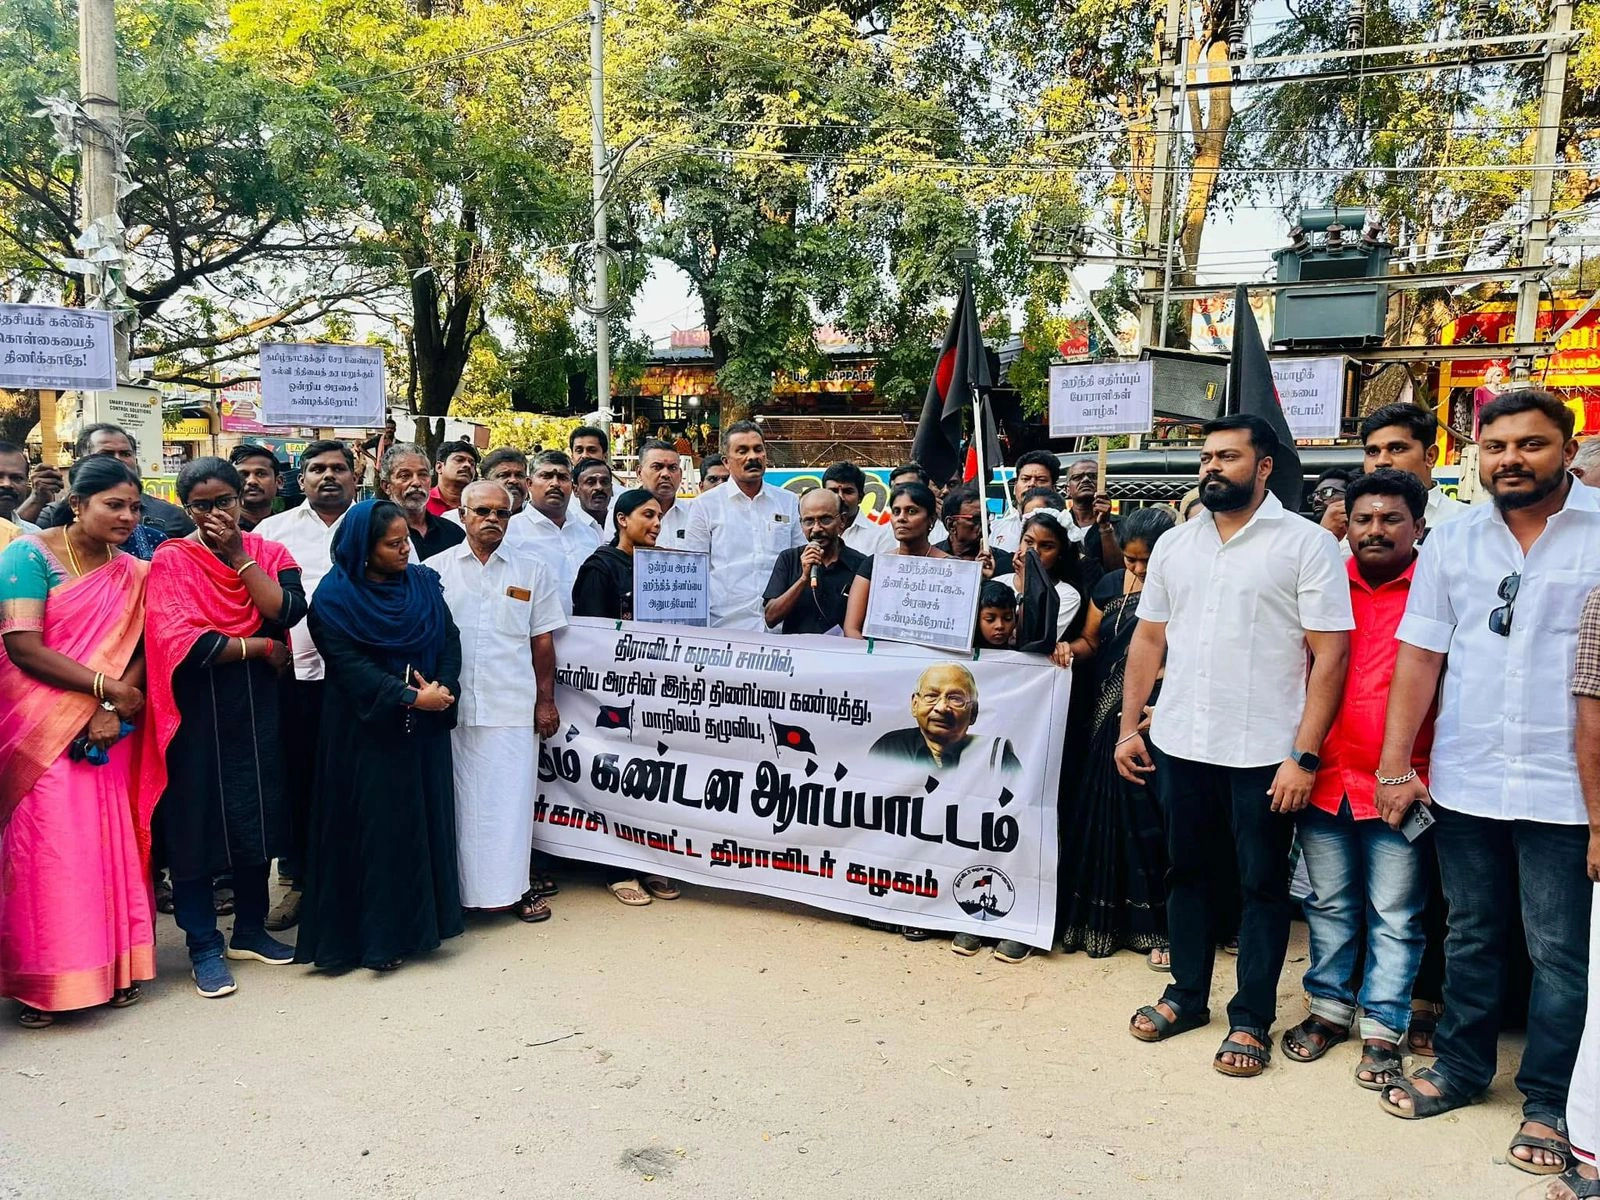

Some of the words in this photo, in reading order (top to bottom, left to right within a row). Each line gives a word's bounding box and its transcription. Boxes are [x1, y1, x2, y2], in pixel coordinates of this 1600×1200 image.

[49, 315, 95, 329] கல்விக்
[4, 350, 87, 367] திணிக்காதே!
[271, 366, 292, 375] கல்வி
[289, 381, 321, 392] ஒன்றிய
[323, 382, 359, 392] அரசைக்
[1061, 374, 1095, 390] ஹிந்தி
[1097, 372, 1141, 387] எதிர்ப்புப்
[291, 396, 358, 408] கண்டிக்கிறோம்!
[1069, 387, 1131, 403] போராளிகள்
[1082, 404, 1118, 418] வாழ்க!
[648, 560, 673, 574] ஒன்றிய
[675, 562, 697, 574] அரசின்
[897, 561, 953, 578] ஹிந்தியைத்
[672, 579, 702, 592] திணிப்பை
[881, 576, 927, 592] திணிக்கும்
[648, 597, 697, 612] அனுமதியோம்!
[902, 593, 940, 610] அரசைக்
[883, 611, 955, 631] கண்டிக்கிறோம்!
[615, 634, 682, 662] திராவிடர்
[684, 643, 733, 672] கழகம்
[736, 647, 795, 677] சார்பில்,
[555, 662, 599, 692] ன்றிய
[602, 671, 657, 697] அரசின்
[661, 675, 706, 707] இந்தி
[709, 680, 786, 709] திணிப்பை
[789, 688, 872, 726] கண்டித்து,
[642, 708, 700, 735] மாநிலம்
[705, 716, 765, 743] தழுவிய,
[590, 741, 744, 814] கண்டன
[751, 758, 1020, 853] ஆர்ப்பாட்டம்
[614, 829, 703, 858] மாவட்ட
[710, 839, 836, 879] திராவிடர்
[846, 868, 939, 897] கழகம்
